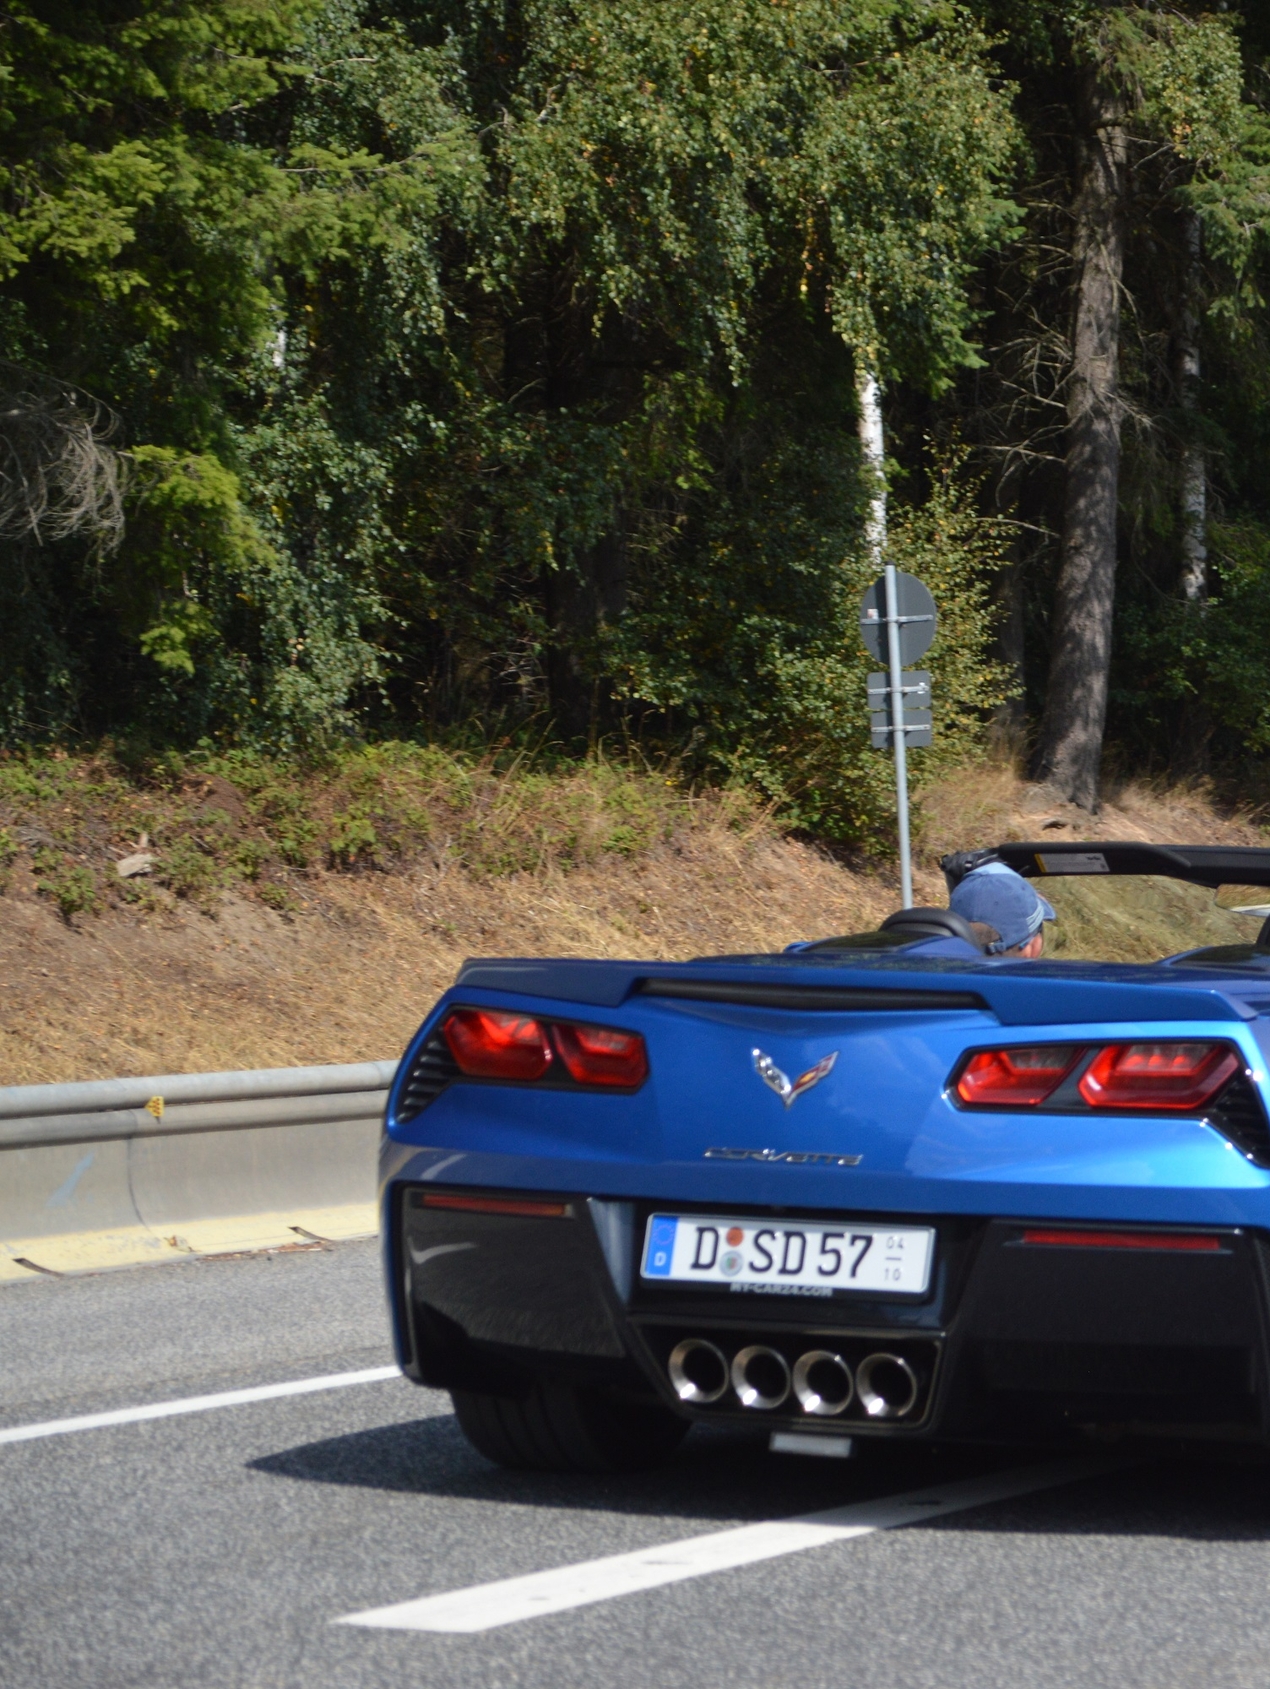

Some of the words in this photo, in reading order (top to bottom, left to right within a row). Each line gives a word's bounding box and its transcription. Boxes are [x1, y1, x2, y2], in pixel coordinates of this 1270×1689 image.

[654, 1254, 667, 1267] D
[690, 1226, 721, 1270] D
[749, 1229, 807, 1276] SD
[817, 1232, 873, 1279] 57
